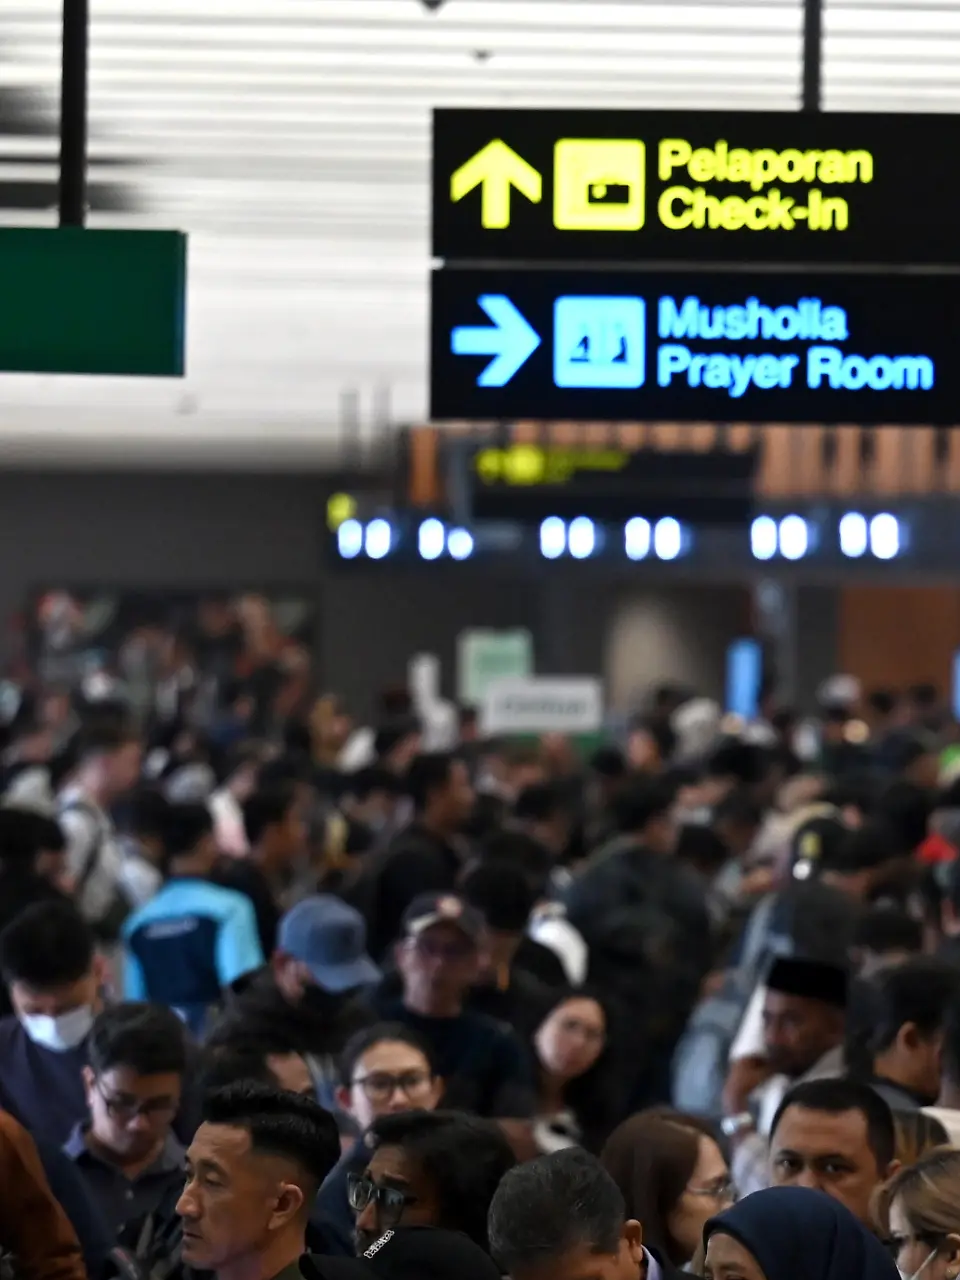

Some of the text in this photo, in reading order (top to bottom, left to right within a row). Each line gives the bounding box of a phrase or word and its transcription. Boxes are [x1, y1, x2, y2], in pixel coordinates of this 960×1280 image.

[658, 139, 873, 191] Pelaporan
[658, 185, 849, 231] Check-In
[657, 296, 848, 340] Musholla
[657, 344, 934, 398] Prayer Room
